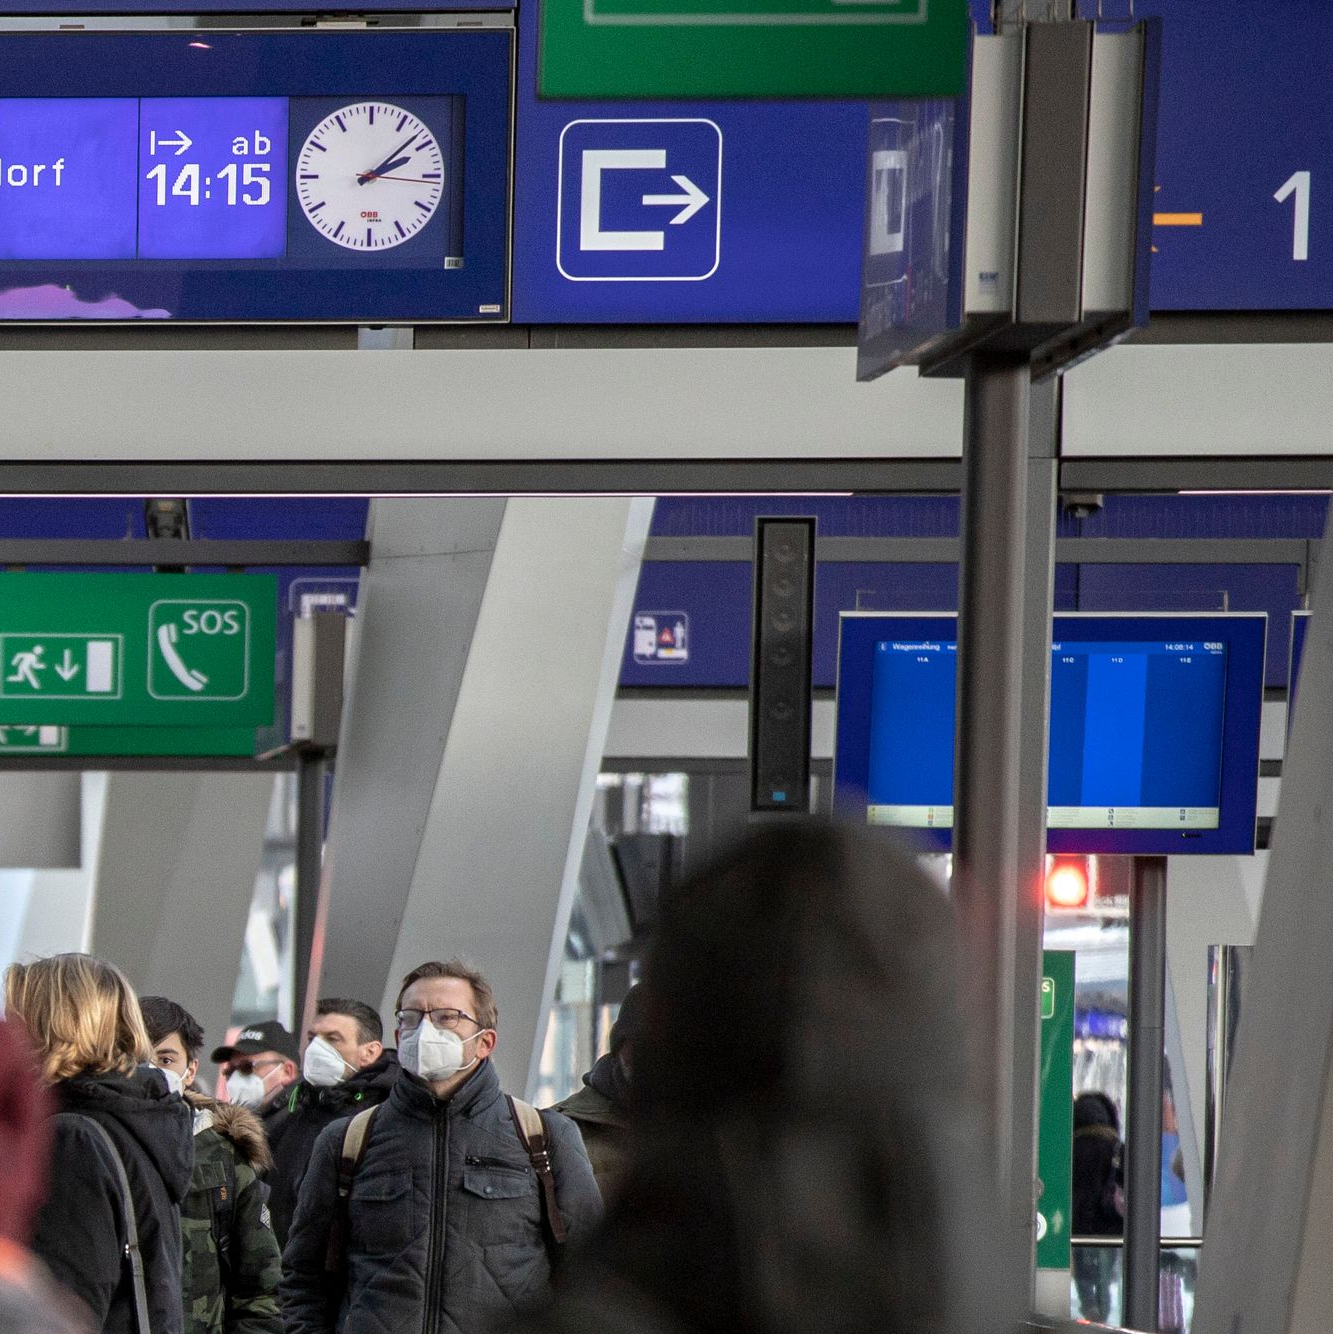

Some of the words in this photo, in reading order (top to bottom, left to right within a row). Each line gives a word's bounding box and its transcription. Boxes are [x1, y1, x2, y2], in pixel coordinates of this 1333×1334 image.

[232, 130, 271, 155] ab
[146, 163, 271, 206] 14:15
[1273, 171, 1311, 260] 1
[182, 609, 239, 635] SOS
